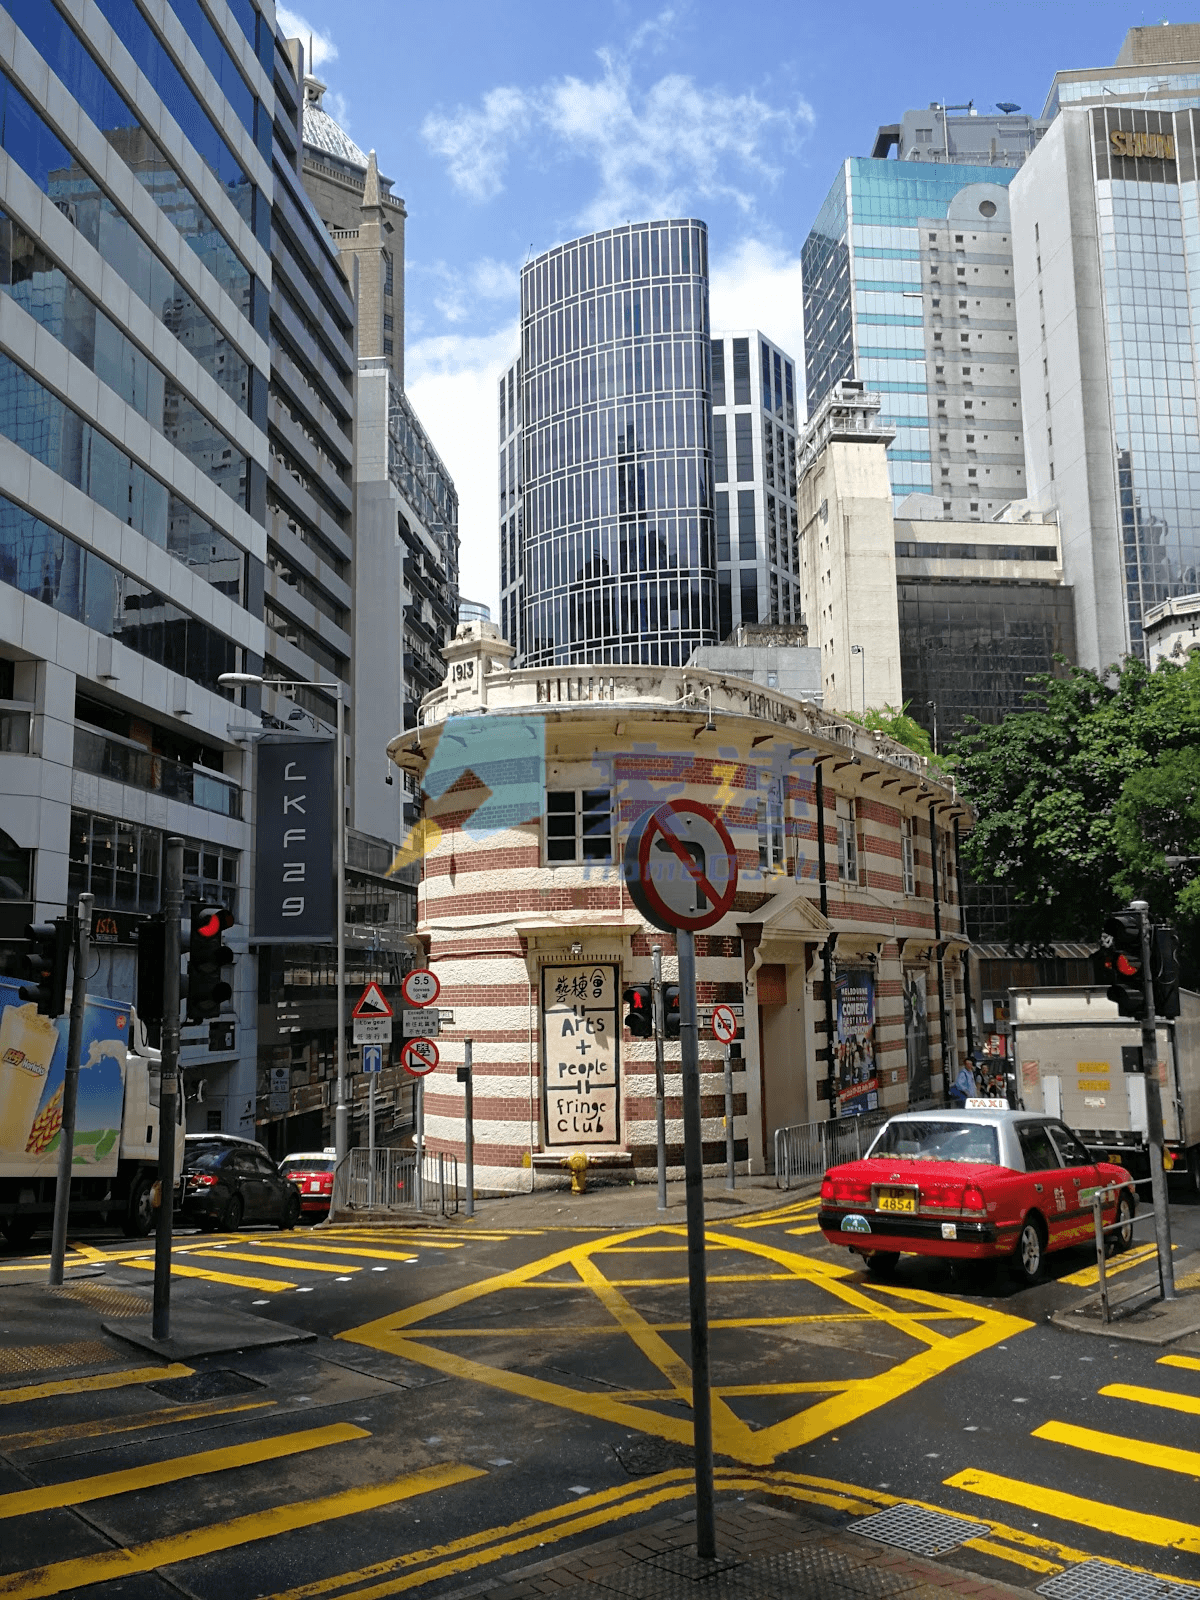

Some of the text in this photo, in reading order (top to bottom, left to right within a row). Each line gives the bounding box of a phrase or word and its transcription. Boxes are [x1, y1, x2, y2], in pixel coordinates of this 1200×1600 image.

[1110, 130, 1175, 160] SHUN
[452, 661, 474, 683] 1913
[414, 976, 429, 985] 5.5
[554, 968, 607, 1003] 藝穗會
[841, 987, 868, 995] MELBOURNE
[842, 1003, 868, 1015] COMEDY
[562, 1018, 605, 1037] Arts
[969, 1099, 1003, 1108] TAXI
[882, 1199, 912, 1211] 4854
